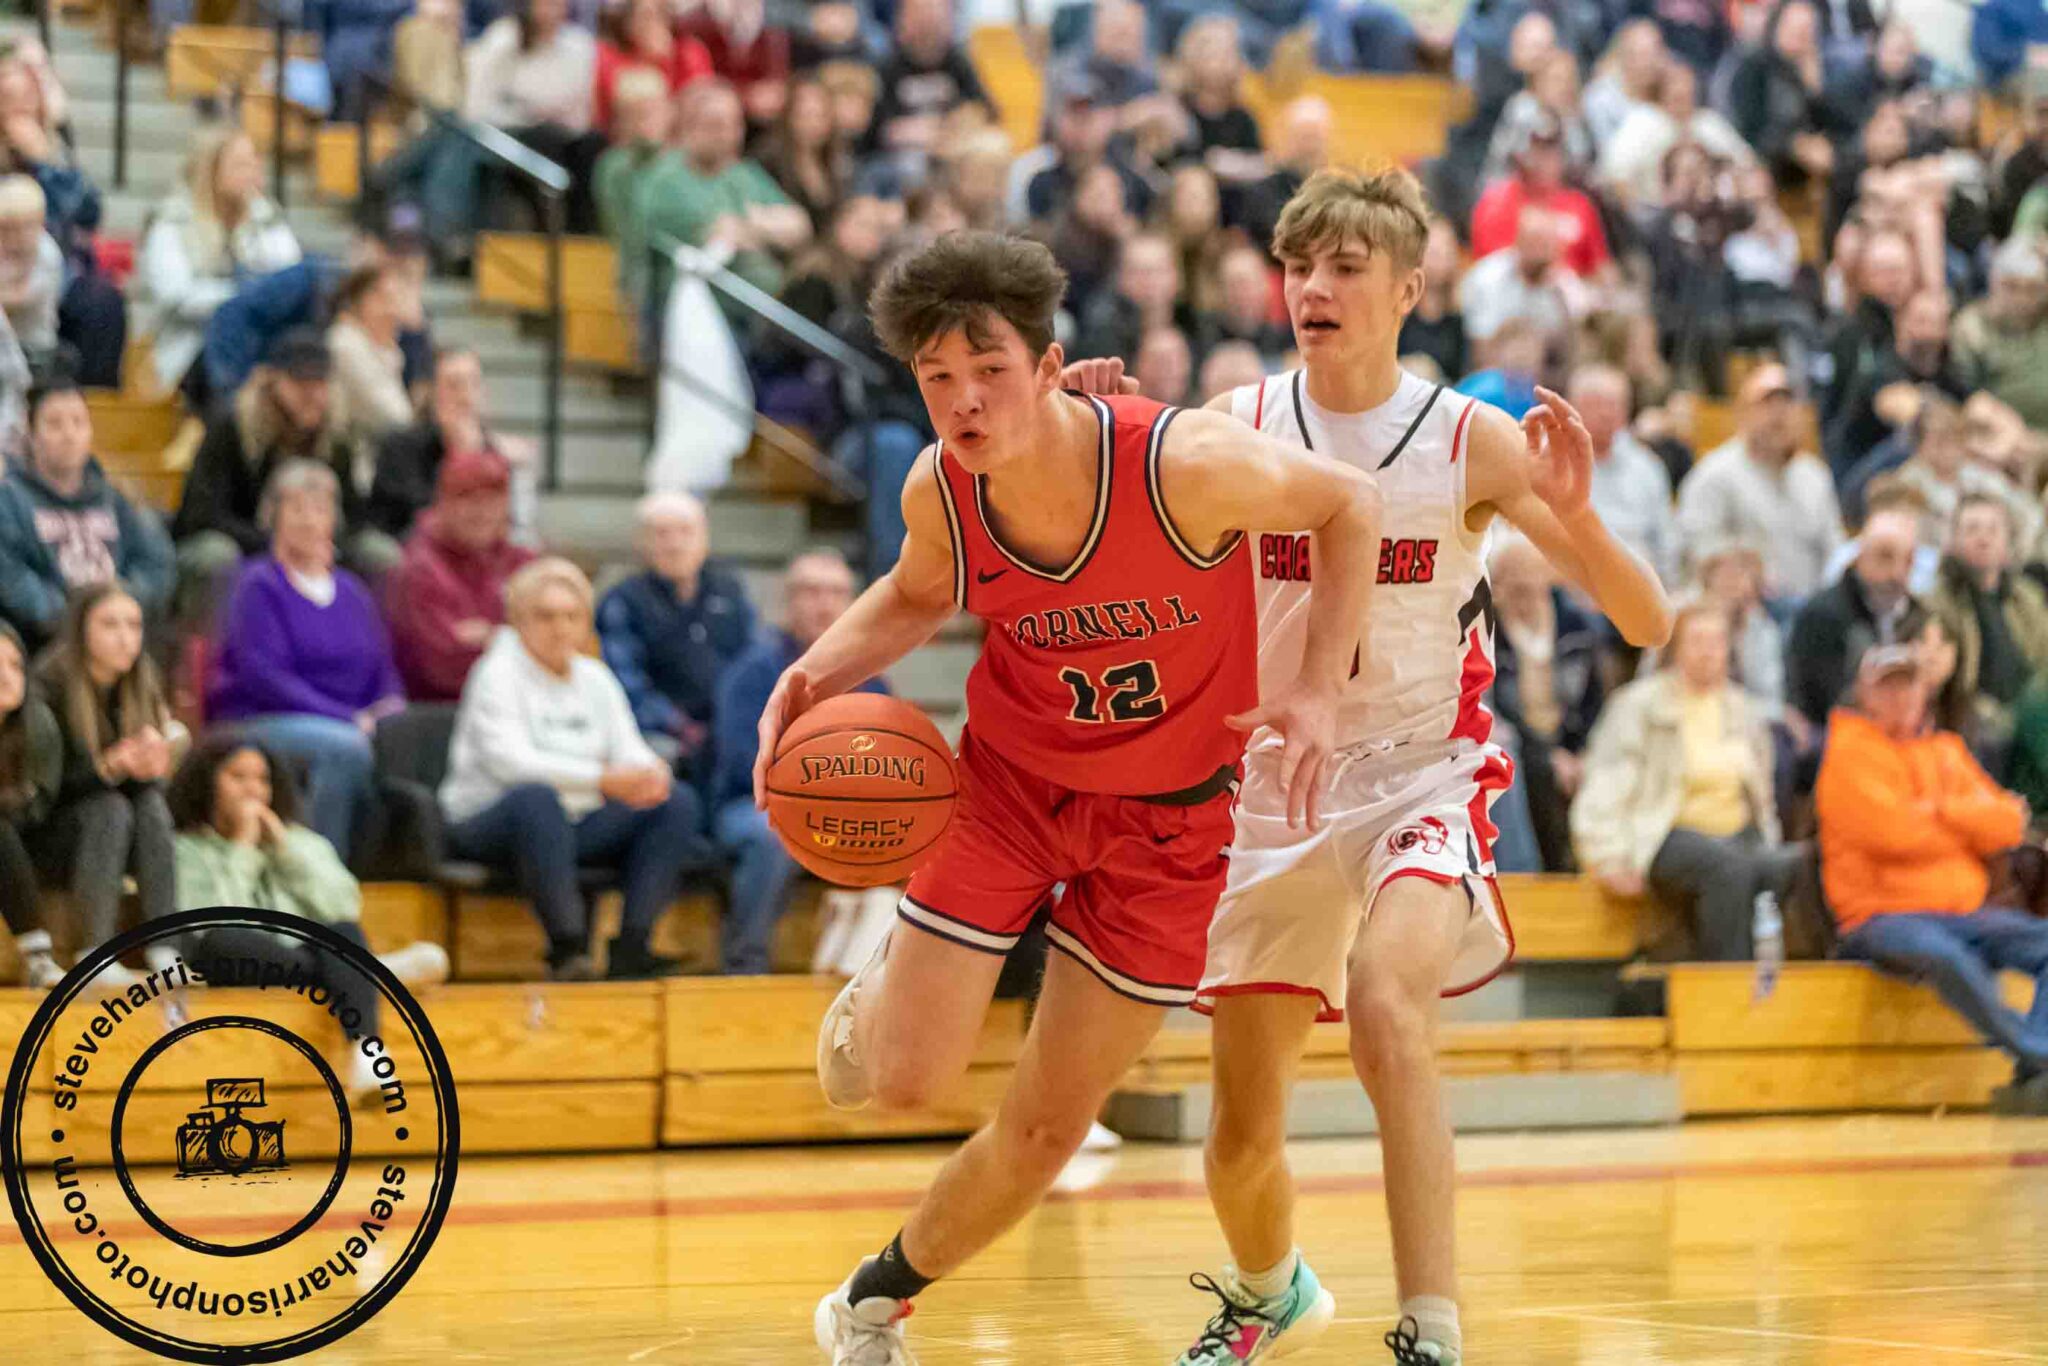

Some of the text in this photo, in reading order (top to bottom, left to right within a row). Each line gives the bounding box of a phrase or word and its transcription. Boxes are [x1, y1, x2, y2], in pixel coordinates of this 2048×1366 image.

[1260, 533, 1438, 584] CHAERS
[1005, 595, 1200, 648] ORNELL
[1058, 660, 1168, 723] 12
[800, 755, 925, 787] SPALDING
[806, 811, 915, 836] LEGACY
